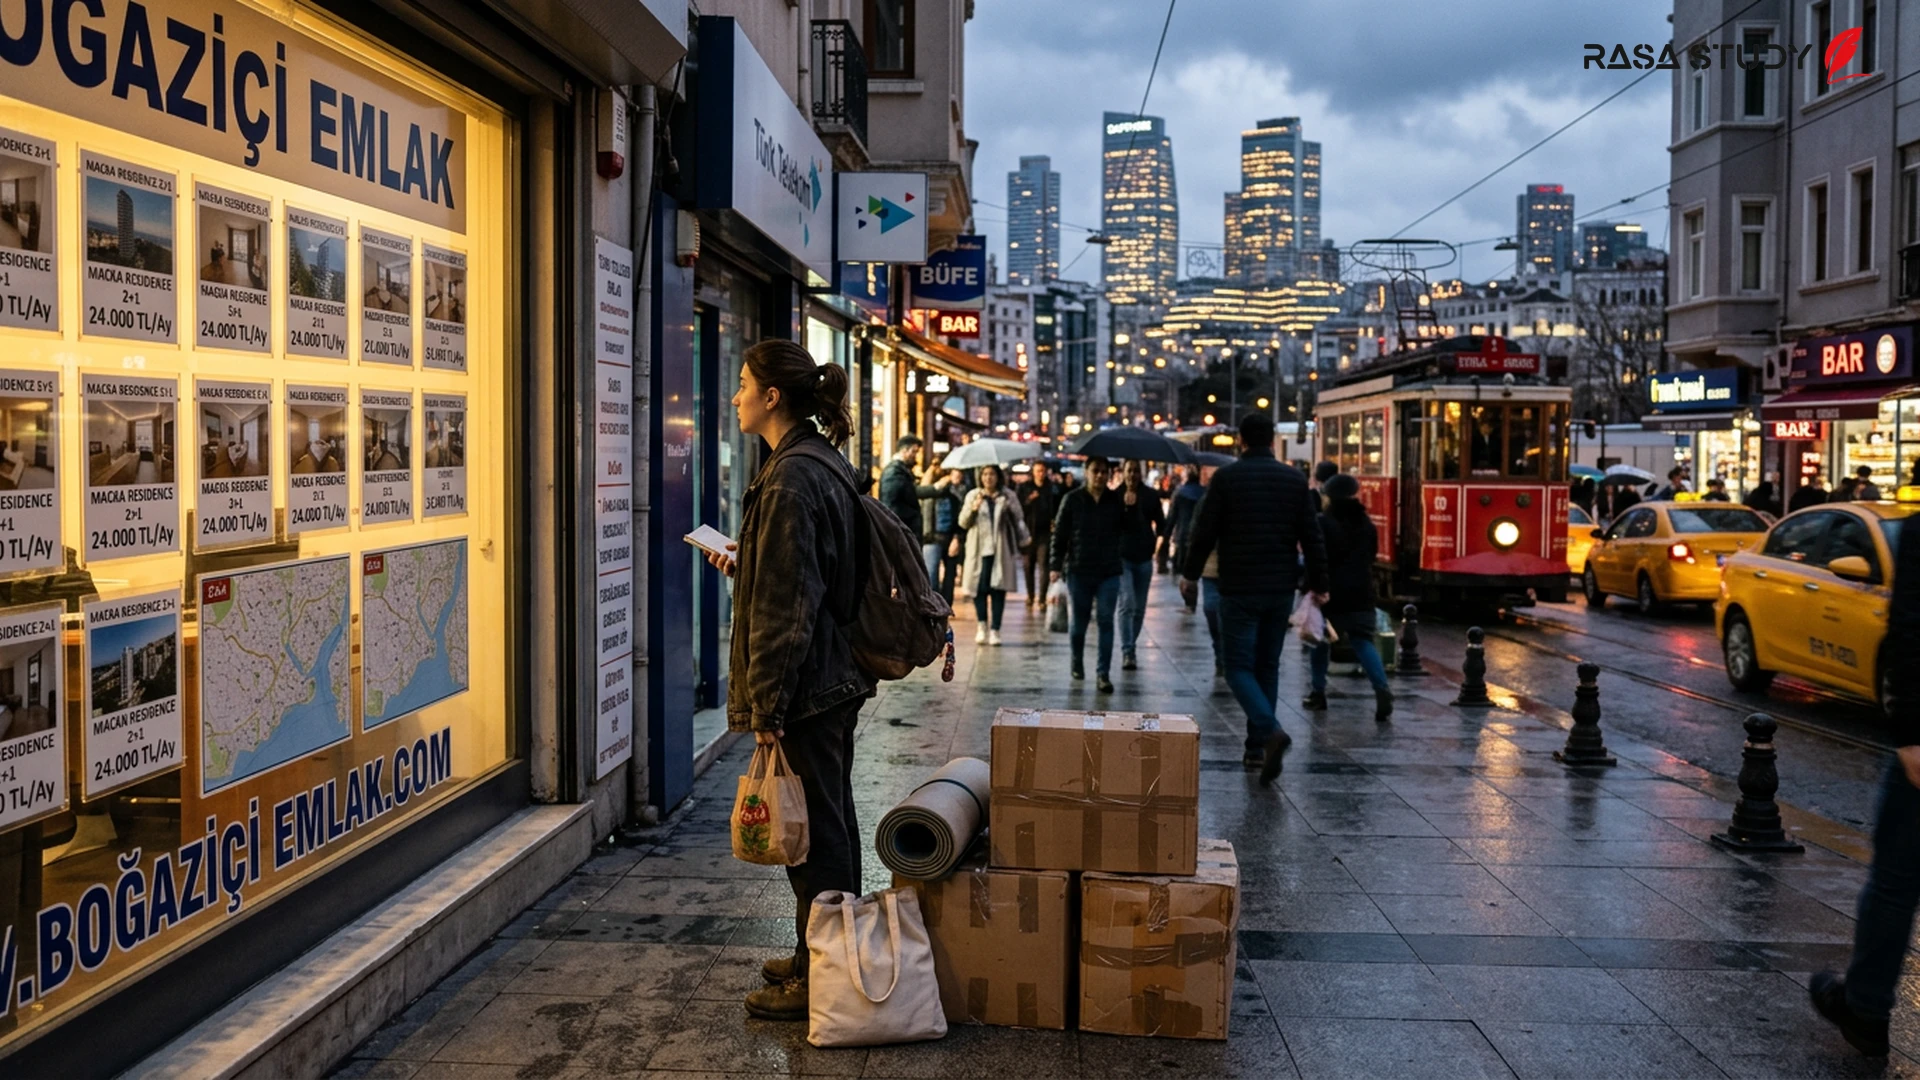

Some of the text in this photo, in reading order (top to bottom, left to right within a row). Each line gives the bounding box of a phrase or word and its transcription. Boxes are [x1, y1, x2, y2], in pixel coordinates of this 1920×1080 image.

[310, 79, 454, 210] EMLAK
[920, 263, 978, 285] BÜFE
[122, 290, 140, 305] 2+1
[89, 306, 172, 336] 24.000 TL/Ay
[202, 320, 267, 346] 24.000 TL/Ay
[941, 316, 978, 332] BAR
[291, 331, 321, 347] 24.000
[1822, 342, 1864, 375] BAR
[1776, 422, 1815, 437] BAR
[92, 523, 173, 550] 24.000 TL/Ay
[203, 515, 237, 535] 24.000
[9, 534, 53, 562] TL/Ay
[0, 733, 55, 762] ESIDENCE
[95, 738, 176, 781] 24.000 TL/Ay
[9, 780, 55, 811] TL/Ay
[0, 727, 453, 1018] .BOĞAZİÇİ EMLAK.COM
